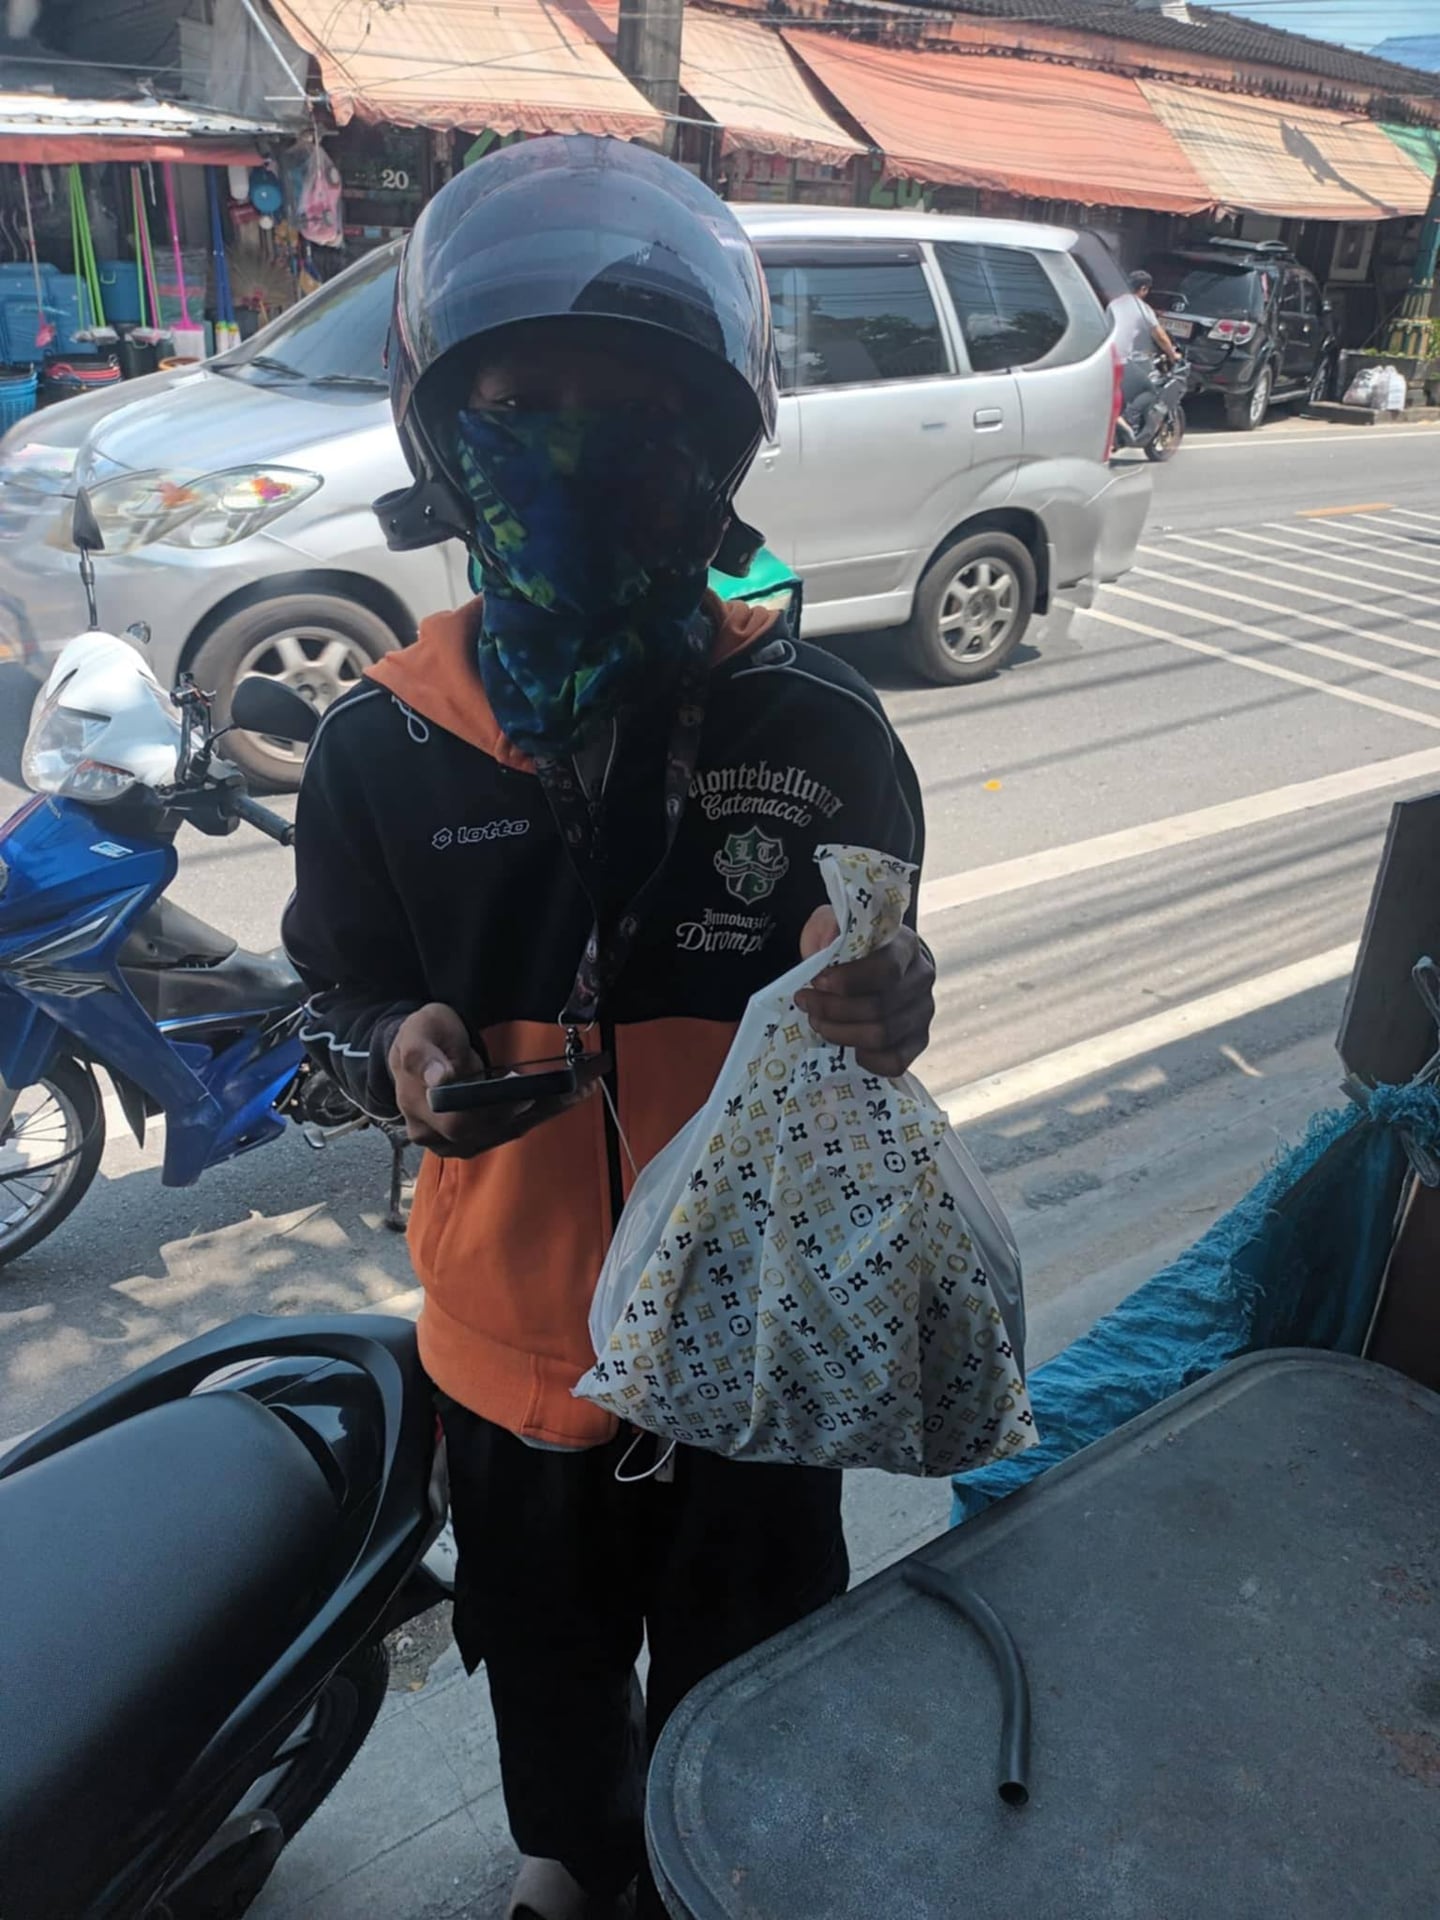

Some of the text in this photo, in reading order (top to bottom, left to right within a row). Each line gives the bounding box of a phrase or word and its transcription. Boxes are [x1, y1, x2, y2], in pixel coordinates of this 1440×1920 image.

[381, 168, 409, 190] 20
[700, 793, 813, 828] Catenaccio
[456, 818, 531, 844] lotto
